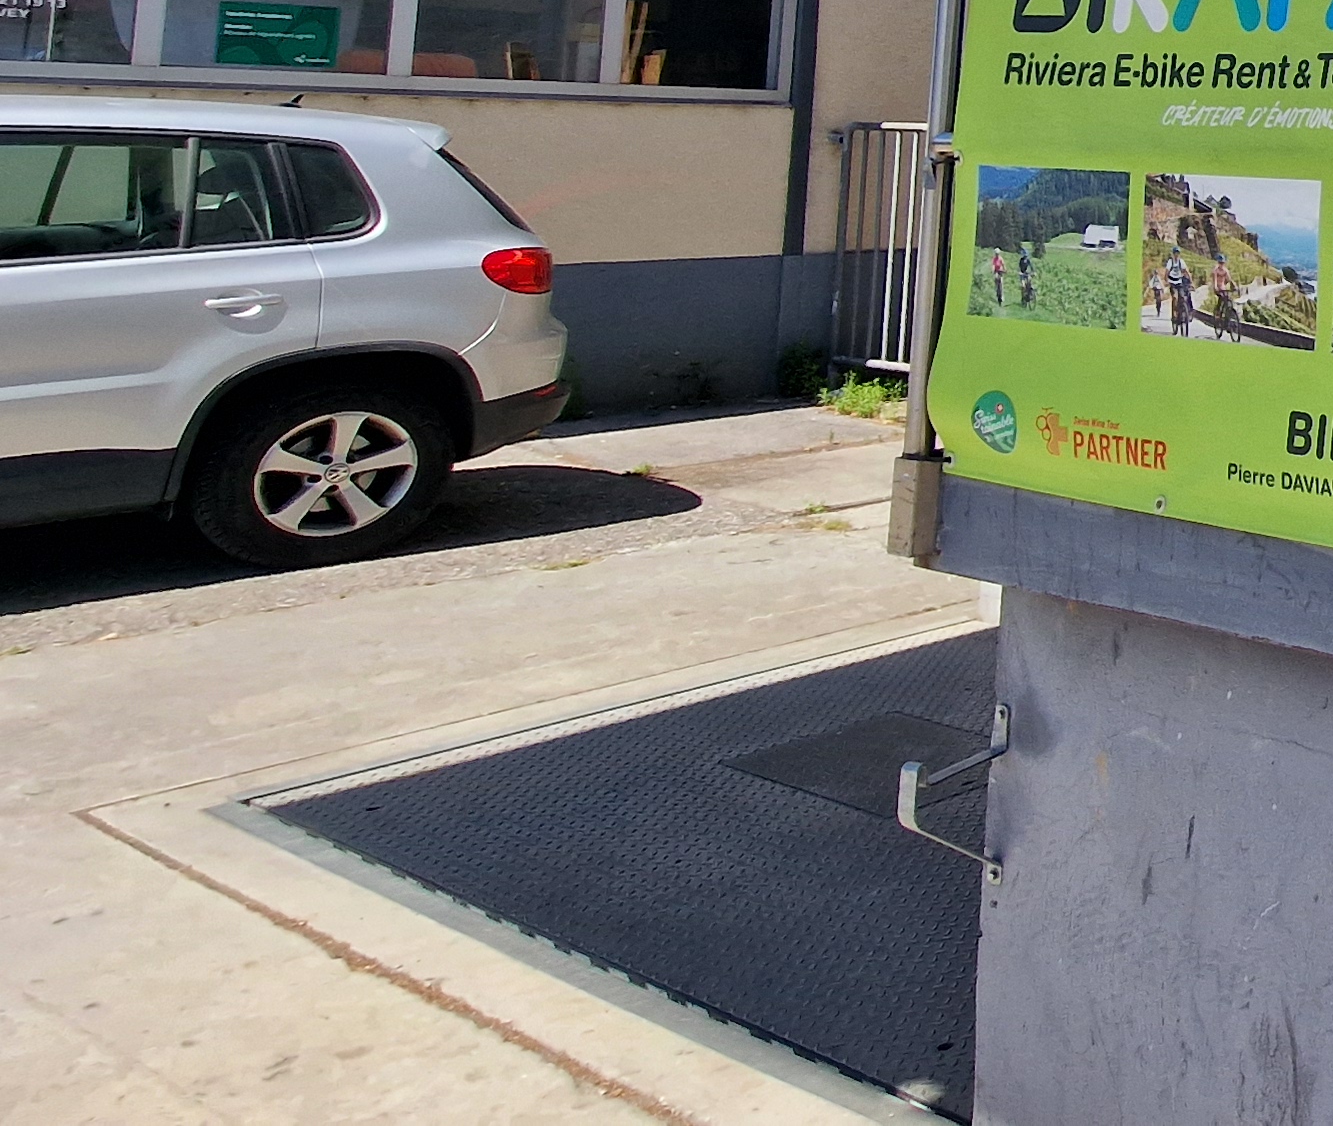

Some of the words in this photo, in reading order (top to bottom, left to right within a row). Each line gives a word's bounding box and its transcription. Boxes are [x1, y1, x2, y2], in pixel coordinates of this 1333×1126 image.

[1003, 52, 1106, 87] Riviera
[1112, 52, 1204, 88] E-bike
[1211, 53, 1290, 89] Rent
[1292, 61, 1312, 89] &
[1161, 99, 1245, 127] CRÉATEUR
[1073, 430, 1167, 471] PARTNER
[1227, 462, 1276, 490] Pierre
